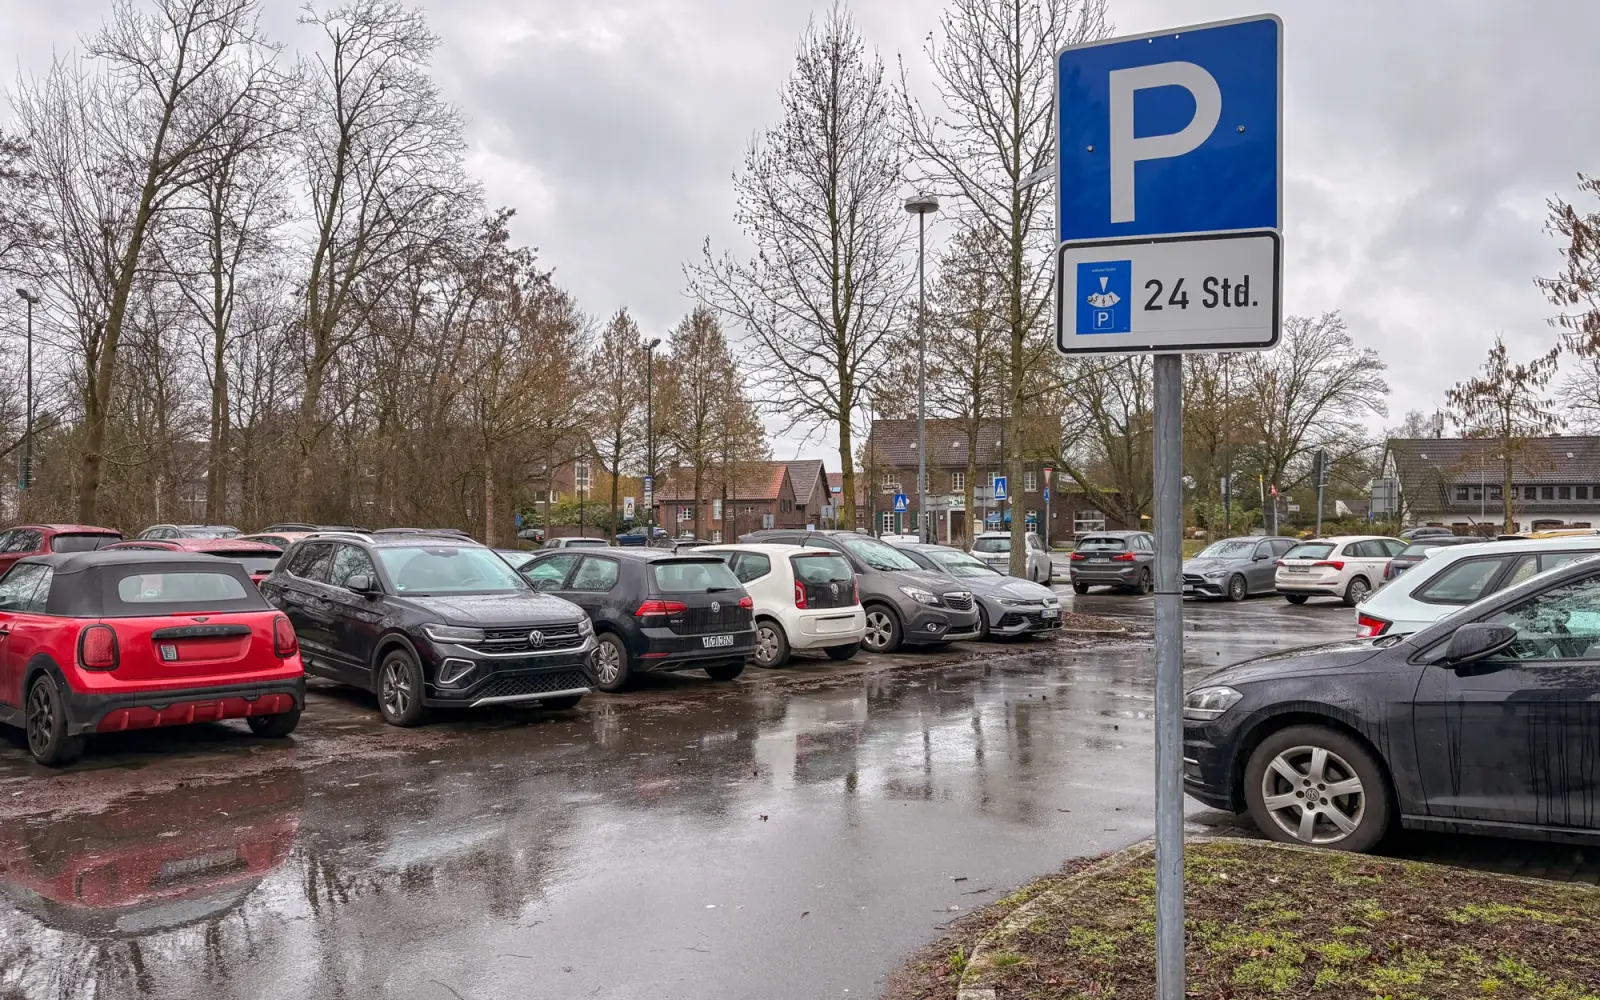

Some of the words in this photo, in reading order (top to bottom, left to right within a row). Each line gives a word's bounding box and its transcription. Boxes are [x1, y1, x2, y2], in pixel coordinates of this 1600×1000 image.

[1109, 61, 1222, 224] P
[1144, 278, 1189, 311] 24
[1202, 274, 1258, 309] Std.
[1098, 312, 1109, 327] P
